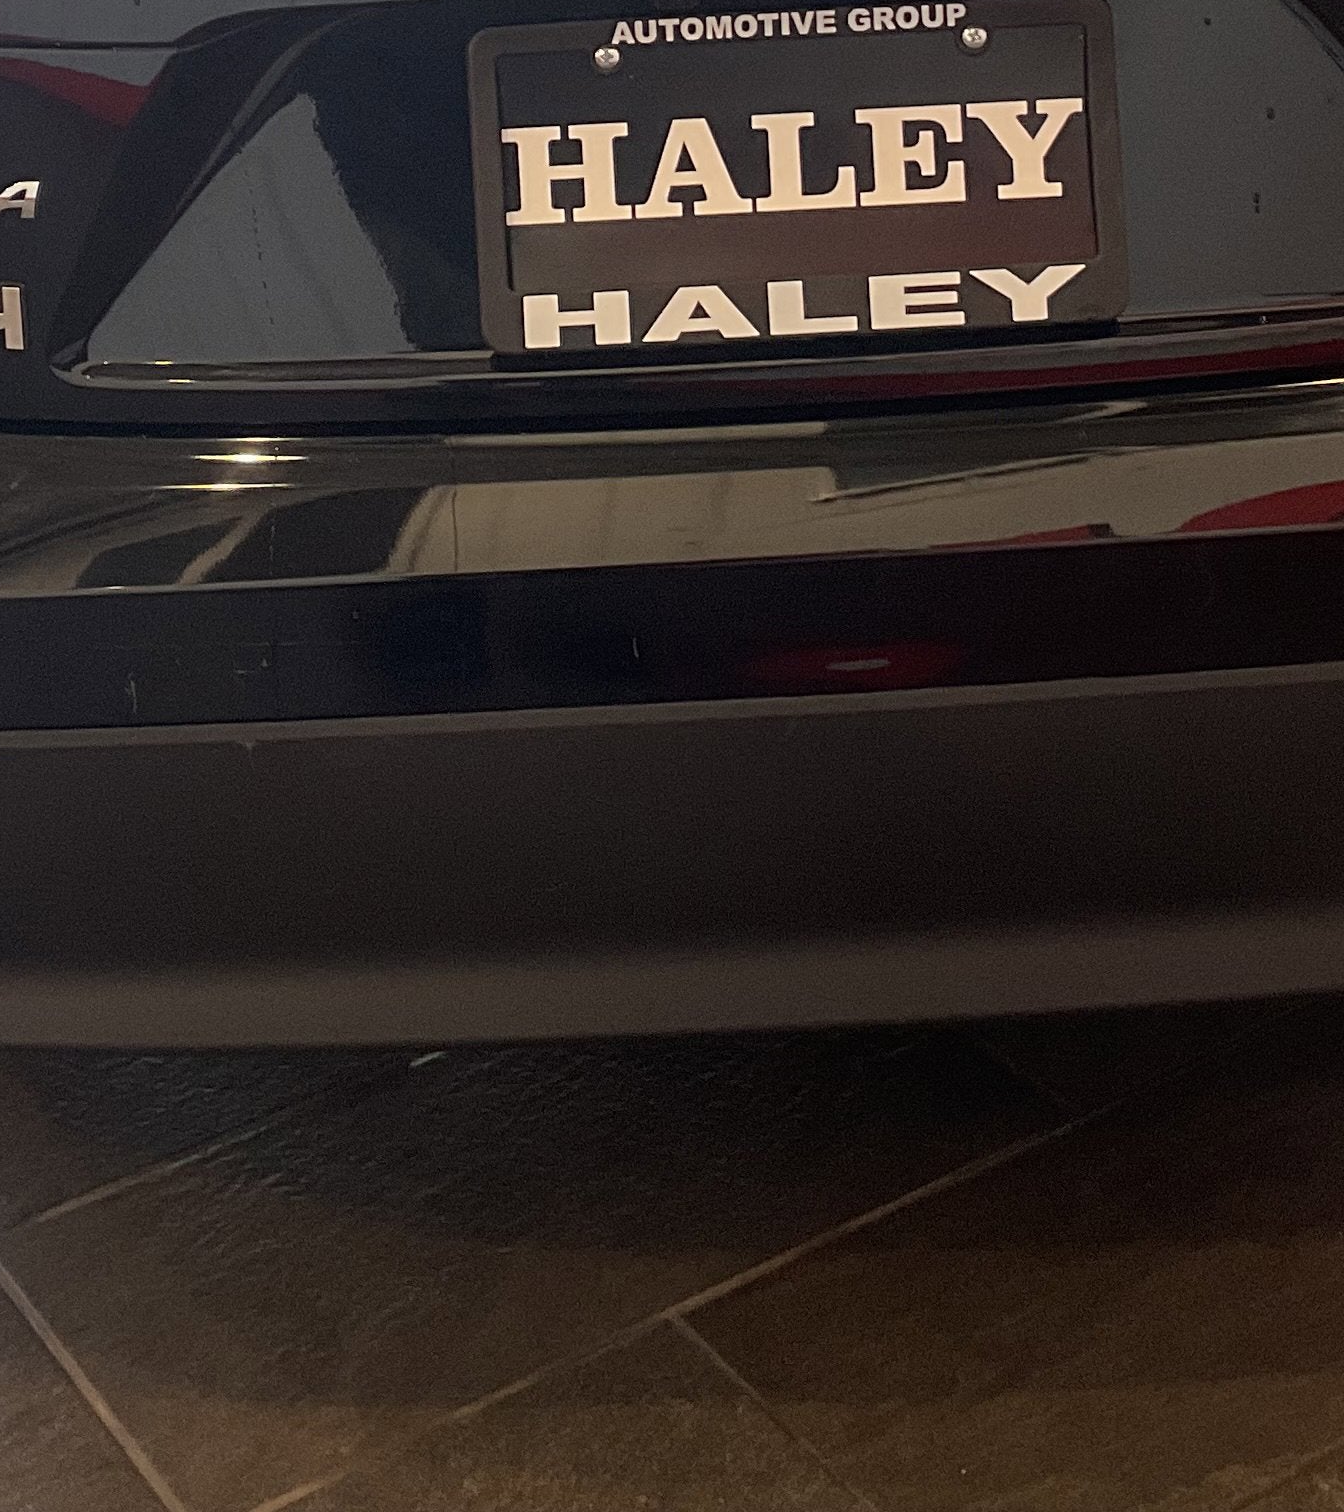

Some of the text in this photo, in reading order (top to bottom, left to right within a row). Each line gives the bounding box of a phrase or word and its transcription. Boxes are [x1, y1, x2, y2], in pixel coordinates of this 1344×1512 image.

[611, 2, 968, 47] AUTOMOTIVE GROUP
[500, 97, 1084, 227] HALEY
[522, 263, 1087, 350] HALEY
